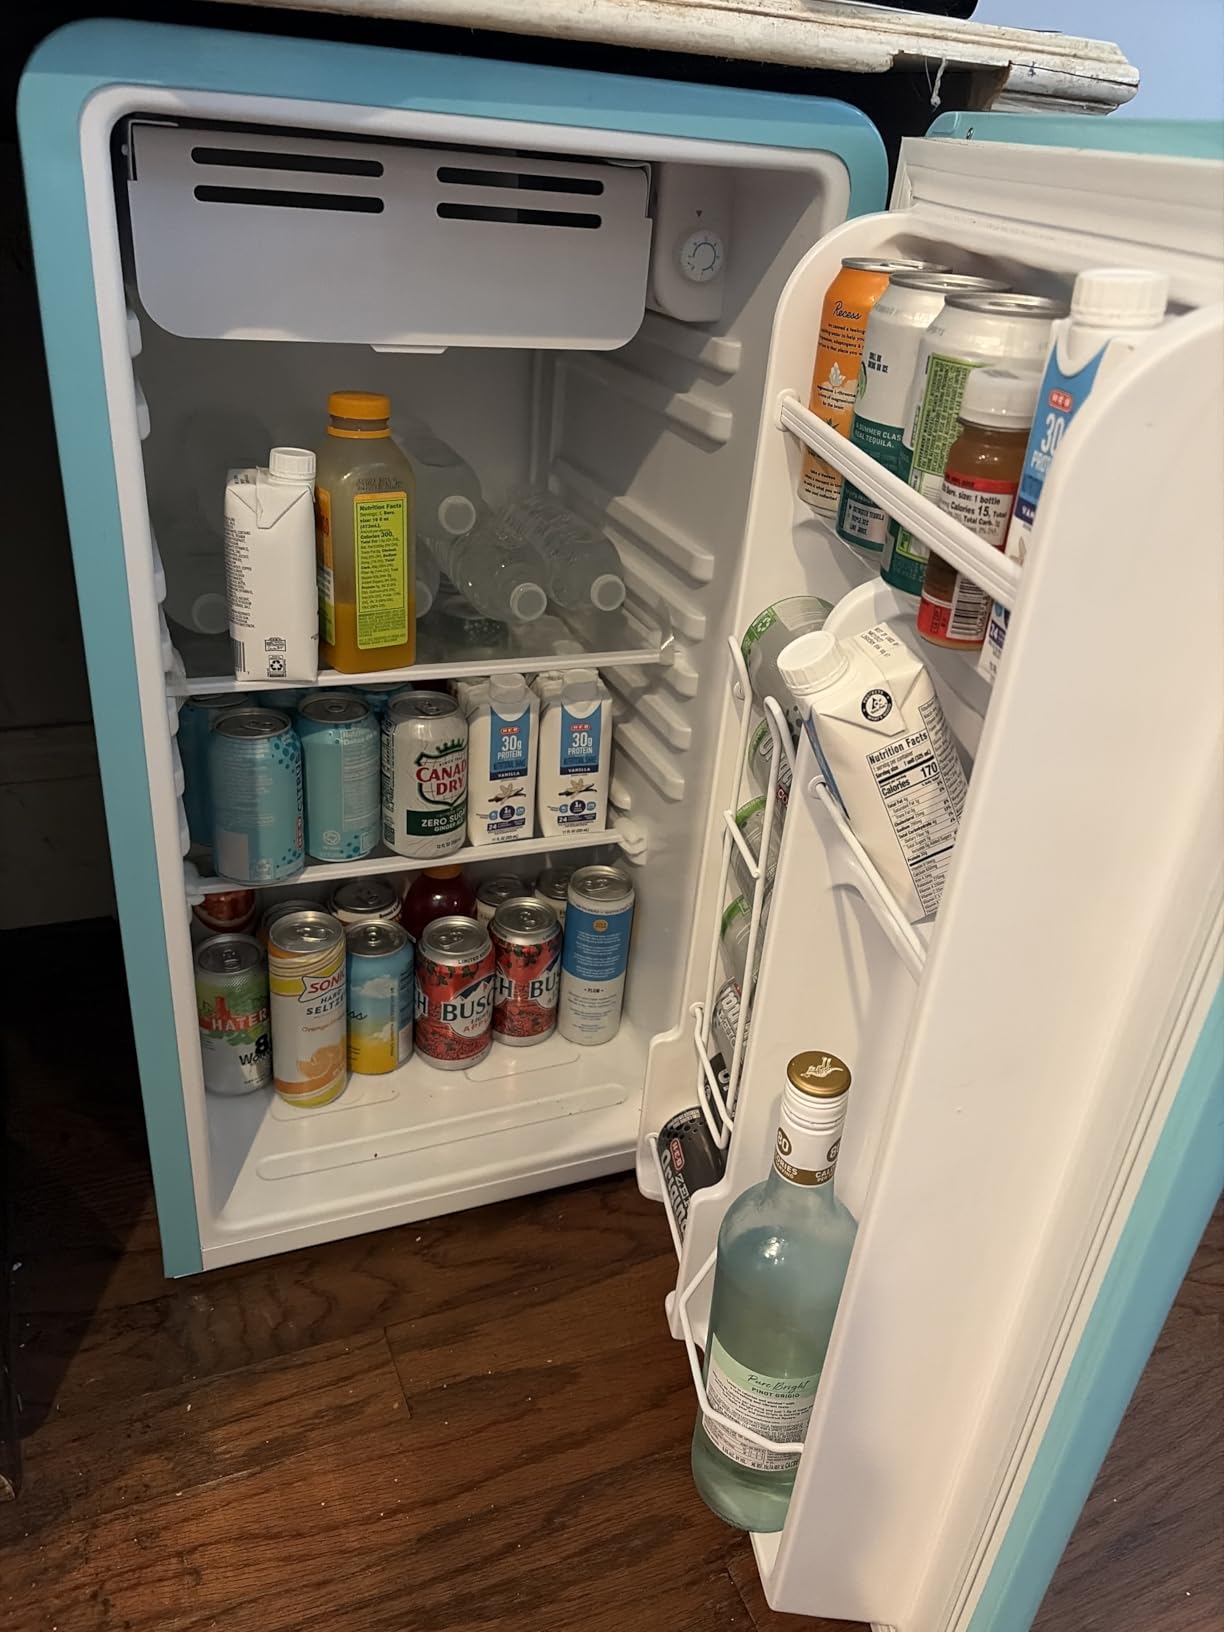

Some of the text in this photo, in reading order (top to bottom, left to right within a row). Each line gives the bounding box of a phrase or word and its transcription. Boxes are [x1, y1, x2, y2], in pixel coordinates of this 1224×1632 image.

[833, 300, 862, 320] Recess
[980, 495, 1001, 506] bottle
[950, 500, 975, 515] Calories
[964, 514, 978, 524] Total
[501, 734, 522, 751] 30g
[572, 732, 592, 748] 30g
[568, 748, 592, 758] PROTEIN
[868, 730, 928, 764] Nutrition Facts
[497, 750, 522, 760] PROTEIN
[875, 768, 890, 779] Serving
[880, 760, 938, 796] Calories 170
[435, 776, 464, 796] DRY
[421, 818, 448, 828] ZERO
[434, 822, 456, 832] GINGER
[748, 1374, 811, 1394] Pure Bright
[752, 1387, 773, 1396] PINOT
